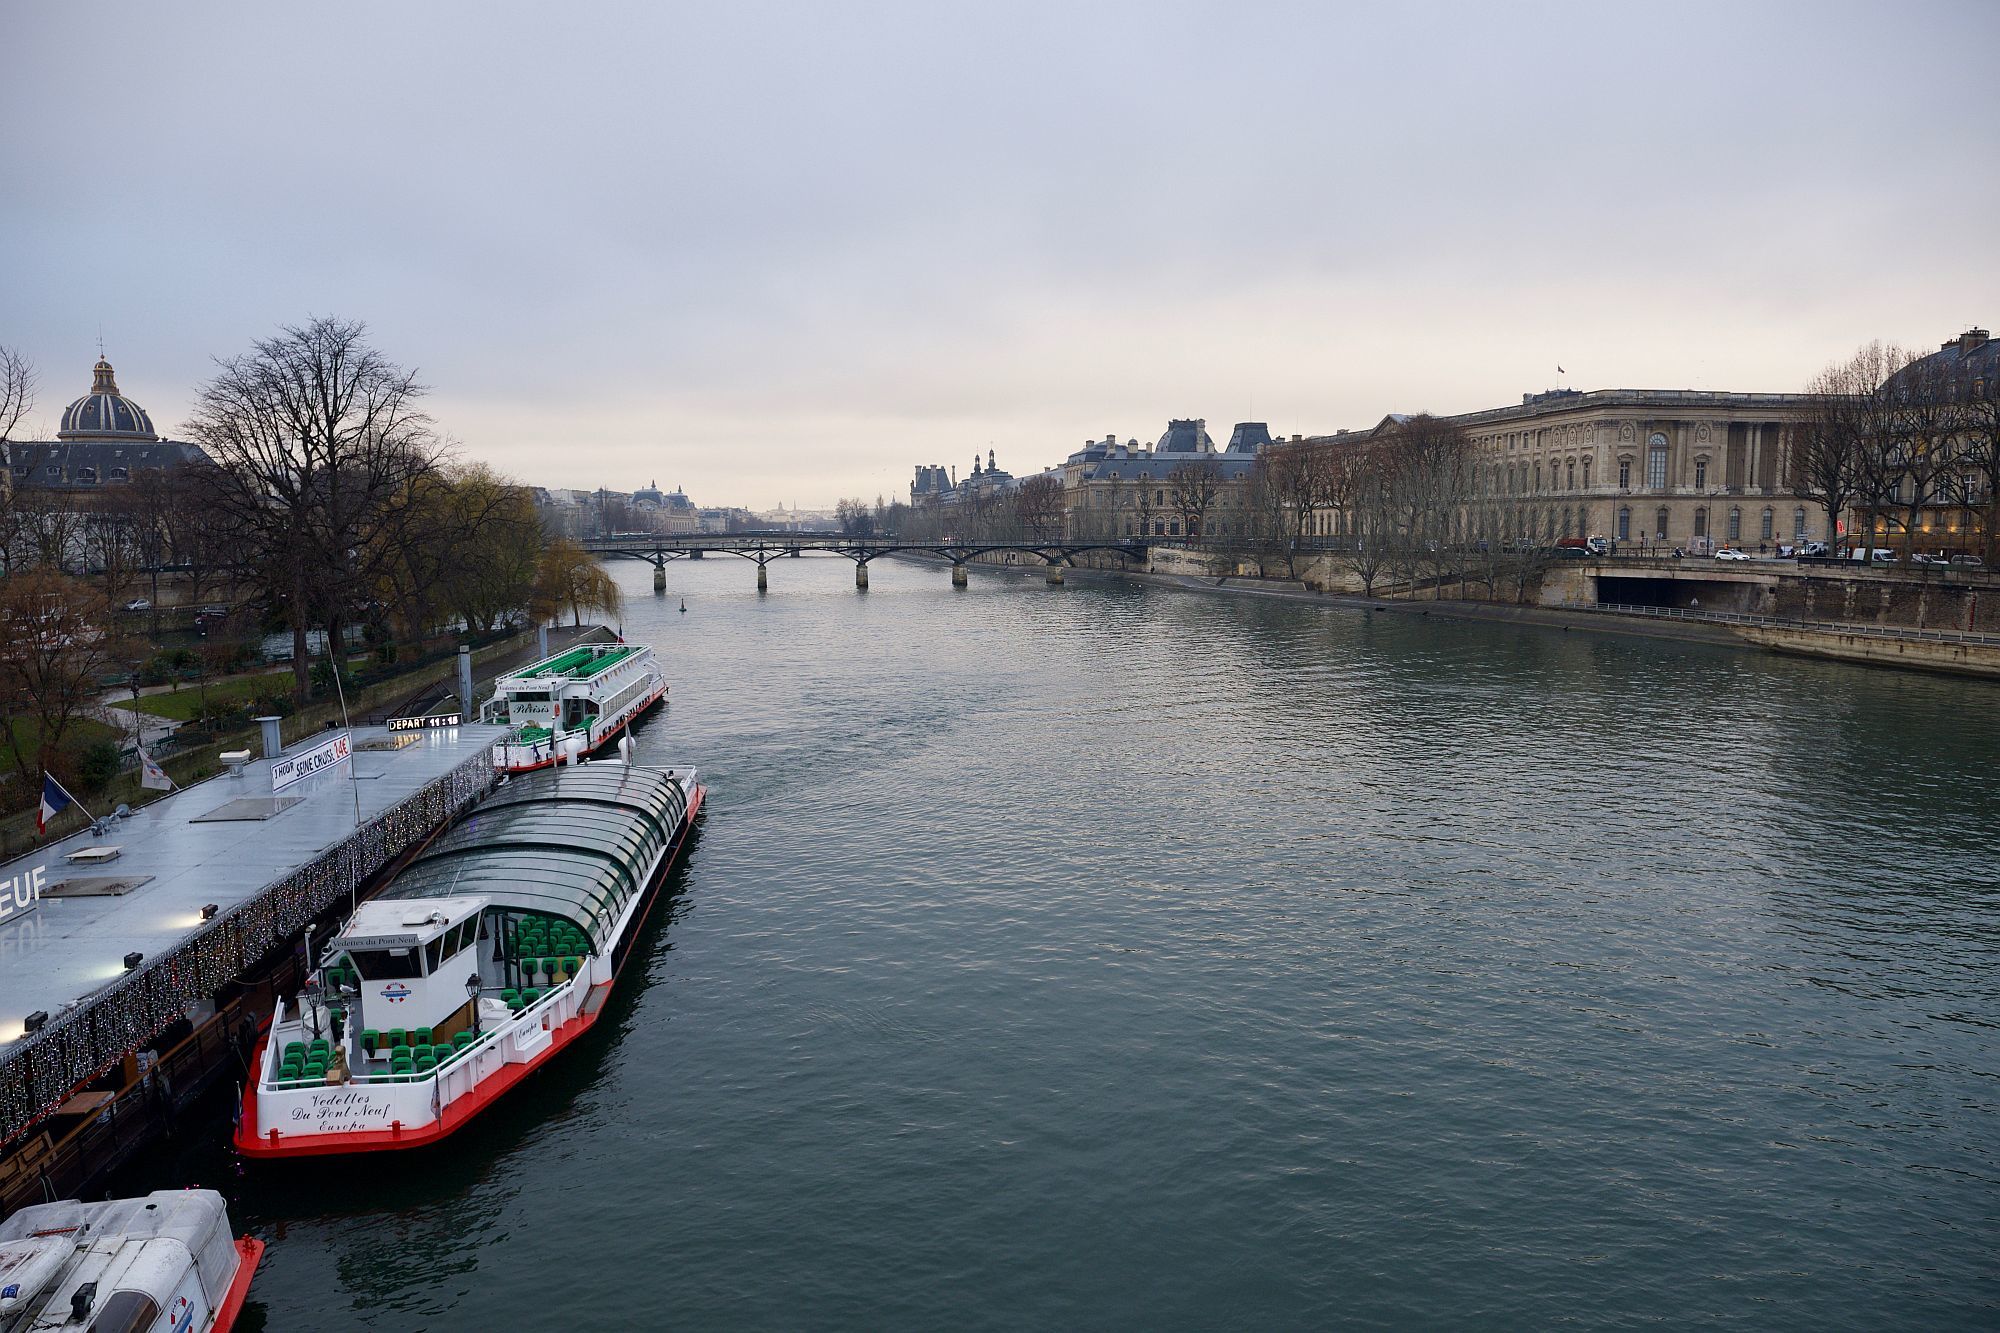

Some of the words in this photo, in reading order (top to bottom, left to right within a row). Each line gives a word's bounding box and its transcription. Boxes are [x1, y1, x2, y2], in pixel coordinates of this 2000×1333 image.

[389, 718, 425, 731] DEPART
[274, 768, 278, 779] 1
[278, 762, 294, 778] HOUR
[296, 757, 313, 777] SEINE
[313, 748, 335, 769] CRUISE
[333, 737, 349, 759] 14€
[291, 1107, 311, 1121] Du
[316, 1106, 351, 1119] Pont
[354, 1103, 391, 1119] Neuf
[319, 1120, 366, 1132] Europa
